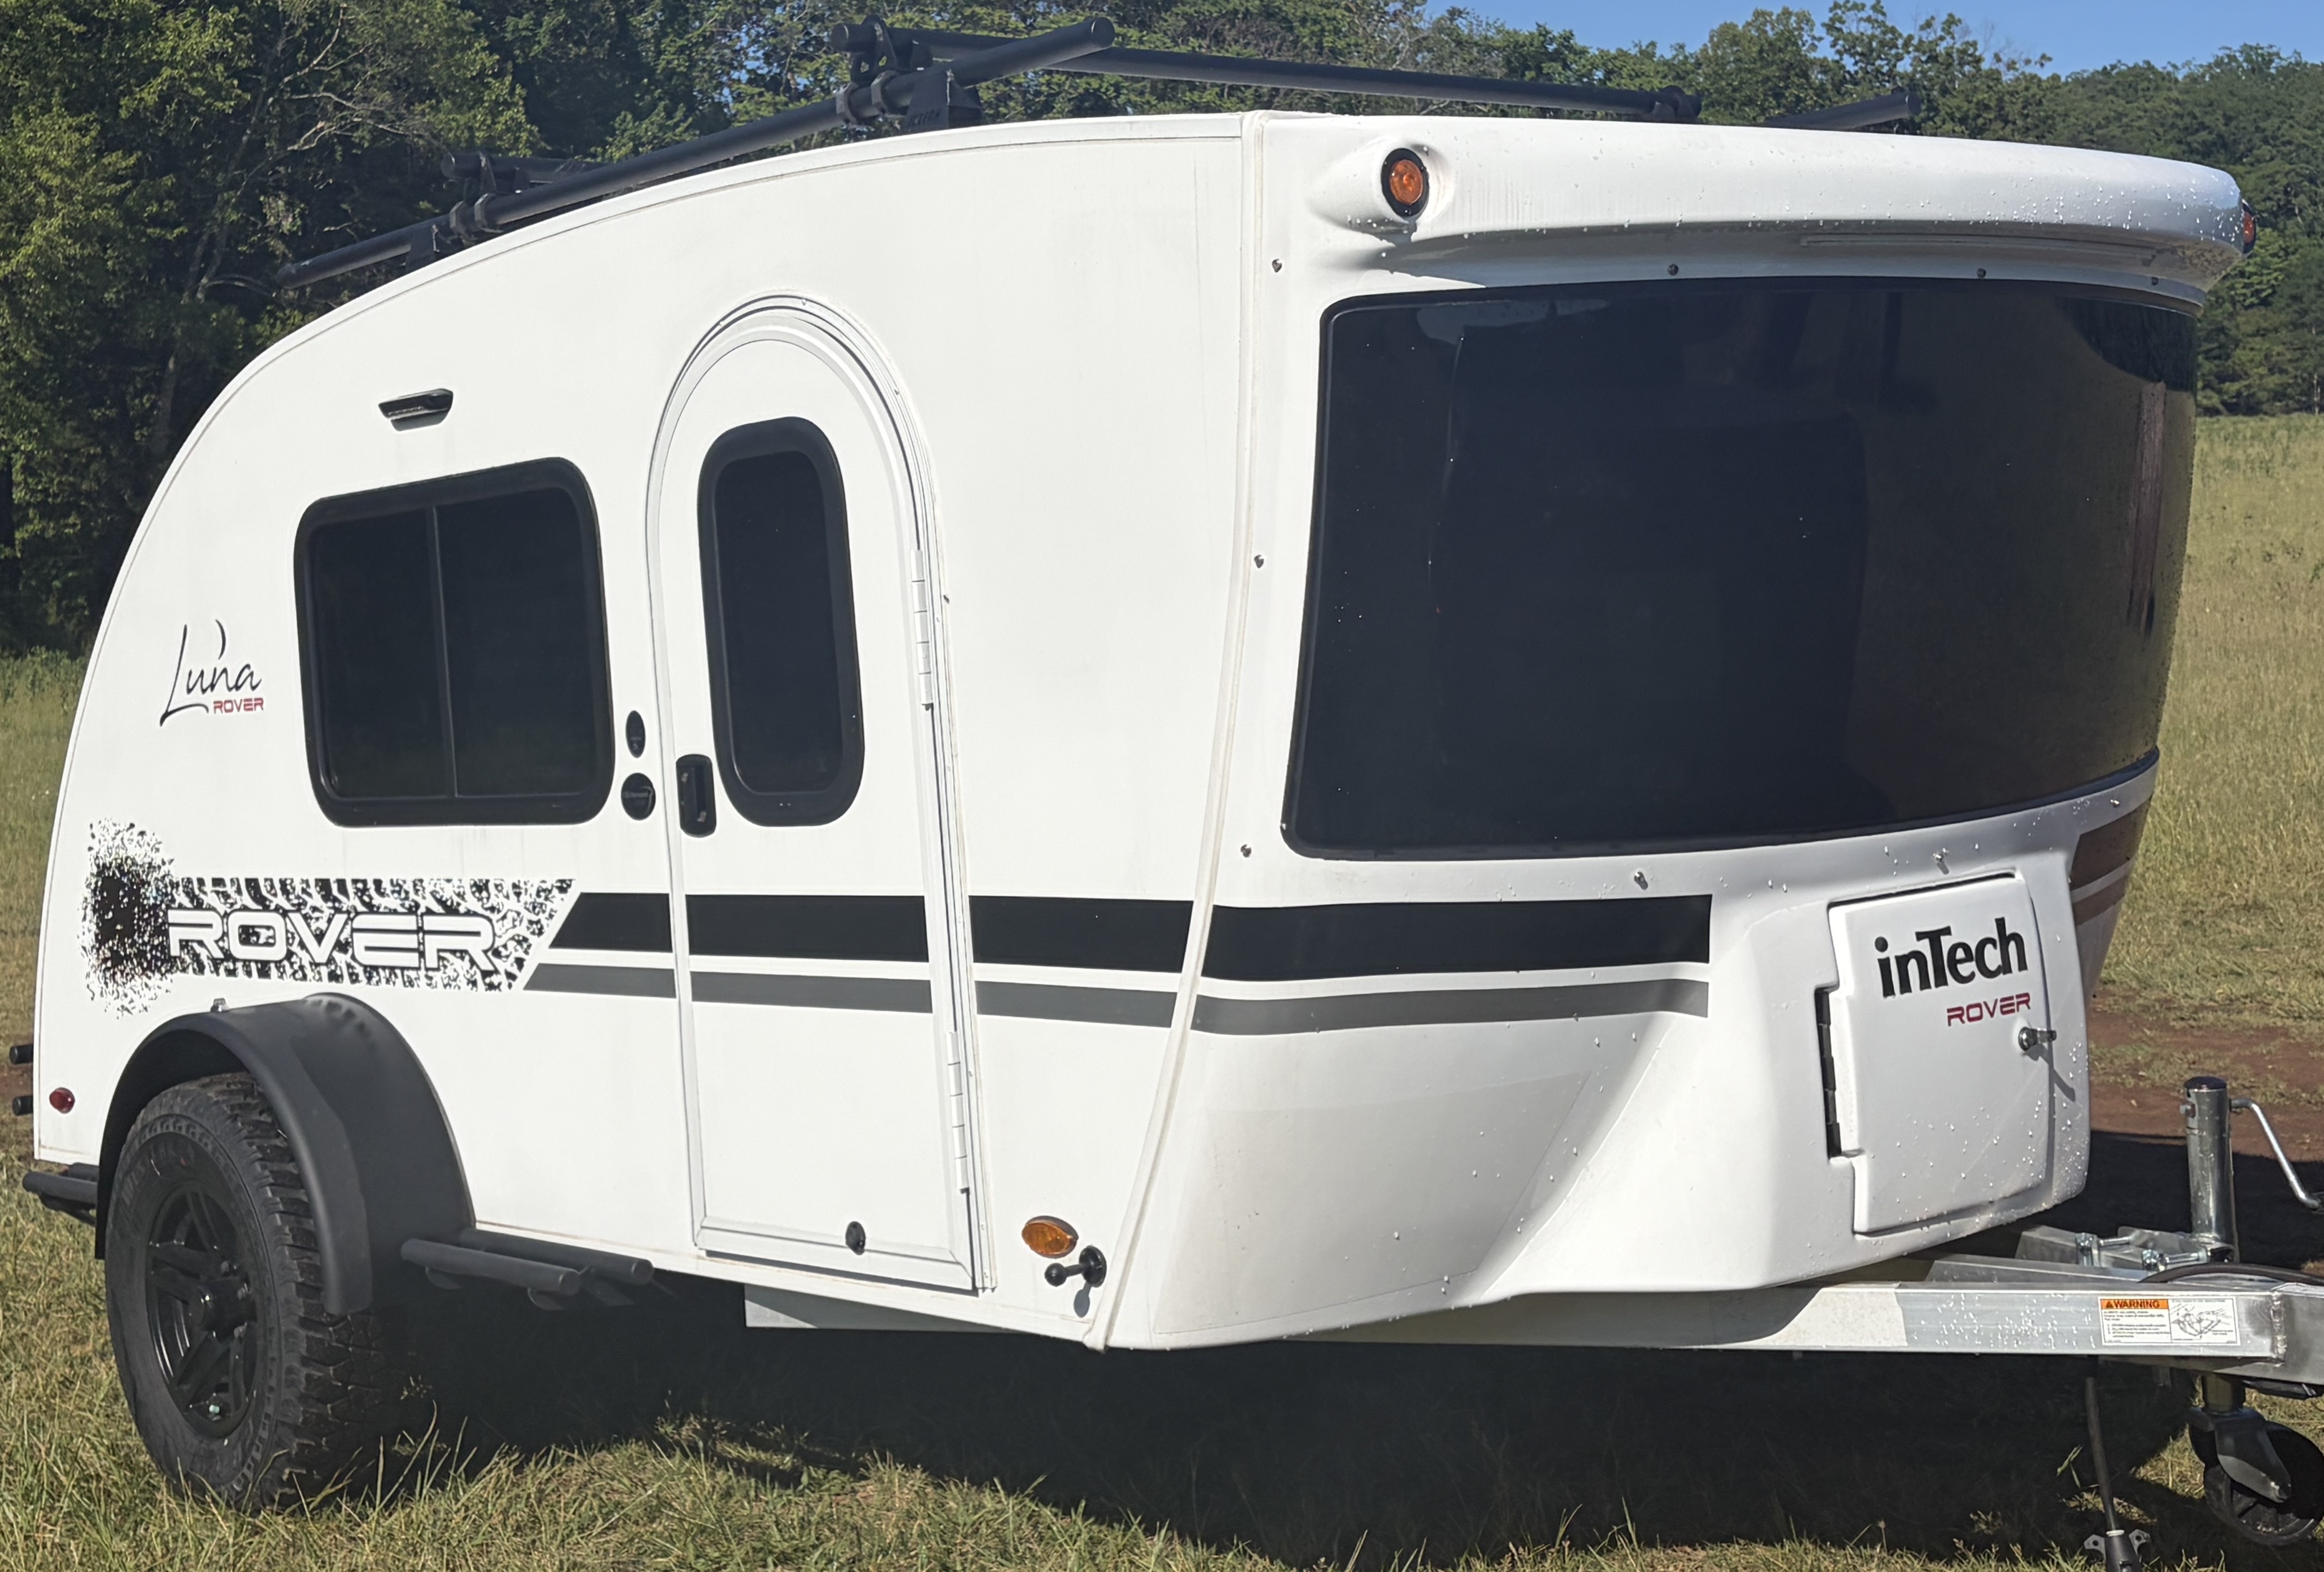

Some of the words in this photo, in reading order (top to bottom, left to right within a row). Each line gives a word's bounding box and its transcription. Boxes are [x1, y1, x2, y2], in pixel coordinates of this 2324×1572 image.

[160, 620, 262, 726] Luna
[213, 697, 264, 714] ROVER
[168, 909, 495, 971] ROVER
[1875, 917, 2028, 998] inTech
[1947, 993, 2031, 1026] ROVER
[2114, 1299, 2160, 1308] WARNING
